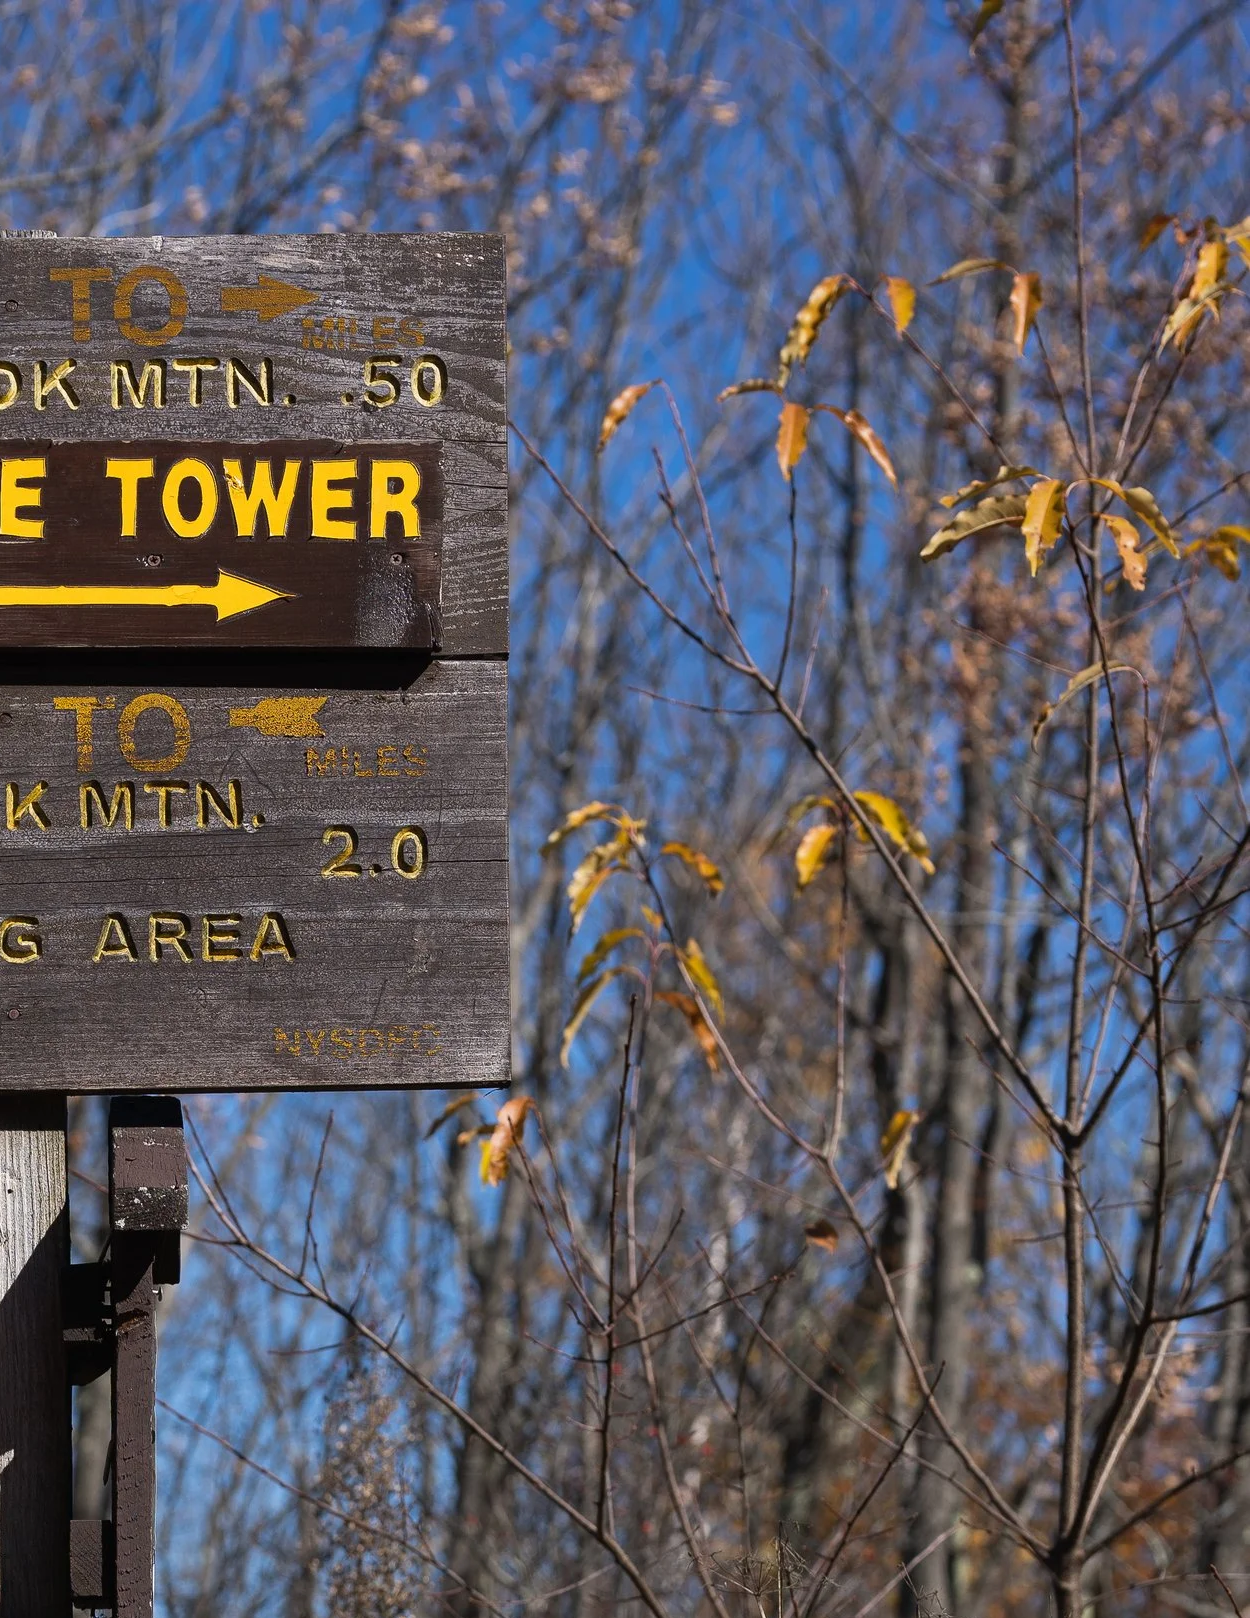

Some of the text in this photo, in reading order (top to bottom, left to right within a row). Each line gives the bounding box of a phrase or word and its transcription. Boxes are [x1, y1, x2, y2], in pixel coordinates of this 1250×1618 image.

[49, 266, 188, 346] TO
[301, 317, 425, 350] MILES
[111, 357, 296, 408] MTN.
[341, 354, 448, 409] .50
[105, 457, 422, 540] TOWER
[53, 692, 191, 773] TO
[306, 745, 428, 778] MILES
[79, 779, 266, 832] MTN.
[320, 823, 429, 880] 2.0
[92, 911, 296, 965] AREA
